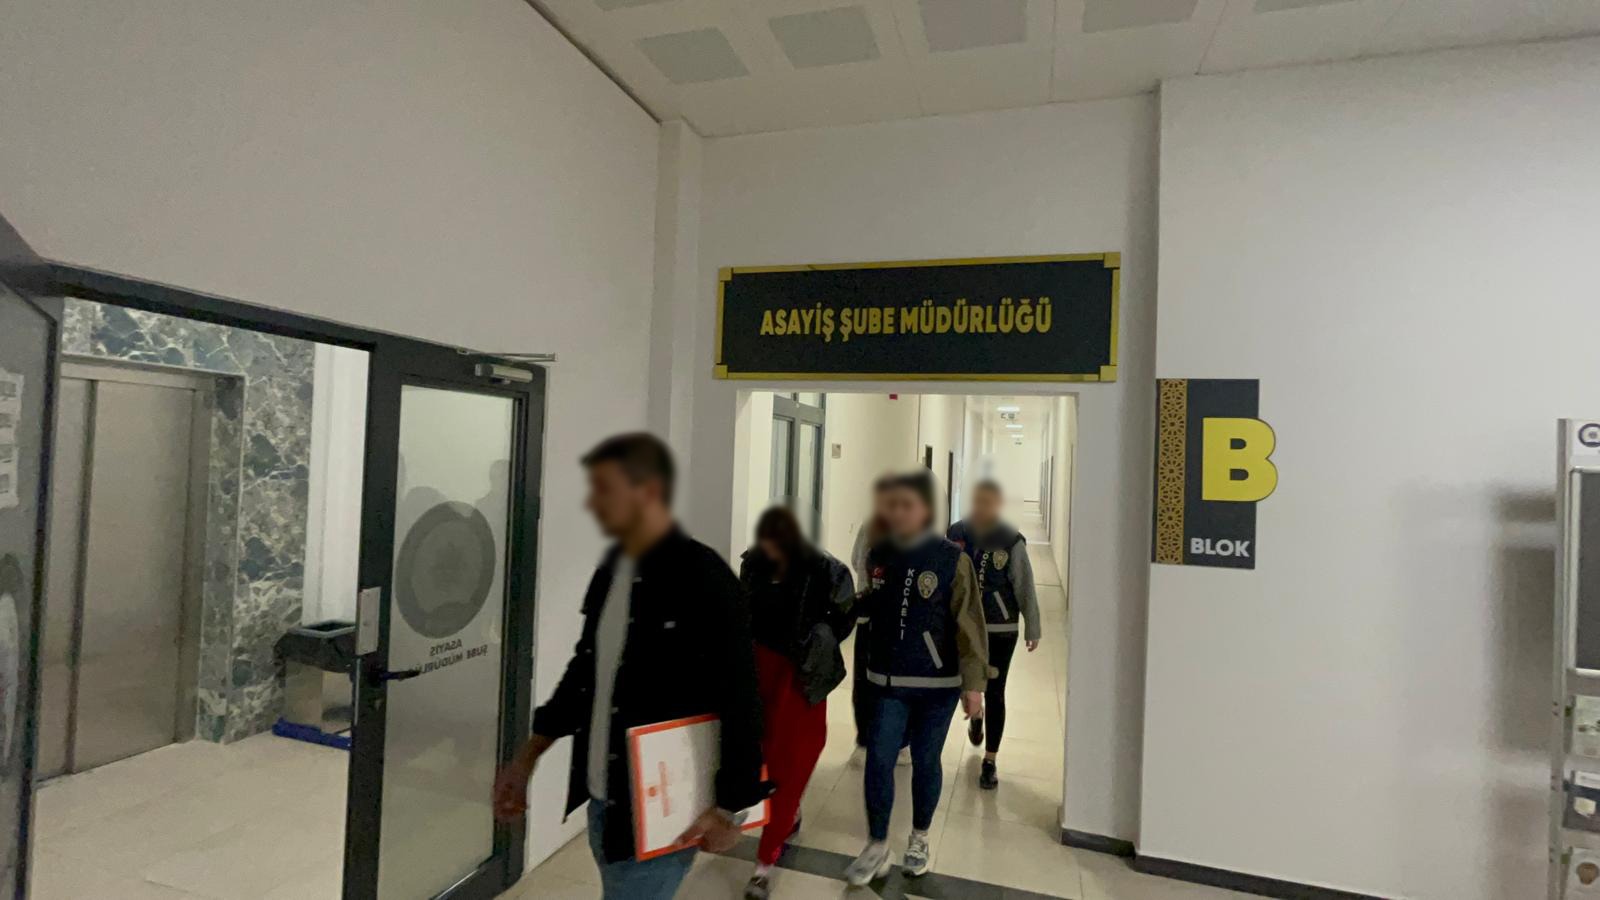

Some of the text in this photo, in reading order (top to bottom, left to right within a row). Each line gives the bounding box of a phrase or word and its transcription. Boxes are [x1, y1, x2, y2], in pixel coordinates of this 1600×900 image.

[760, 298, 1052, 342] ASAYİŞ ŞUBE MÜDÜRLÜĞÜ
[1202, 417, 1278, 502] B
[1190, 537, 1250, 557] BLOK
